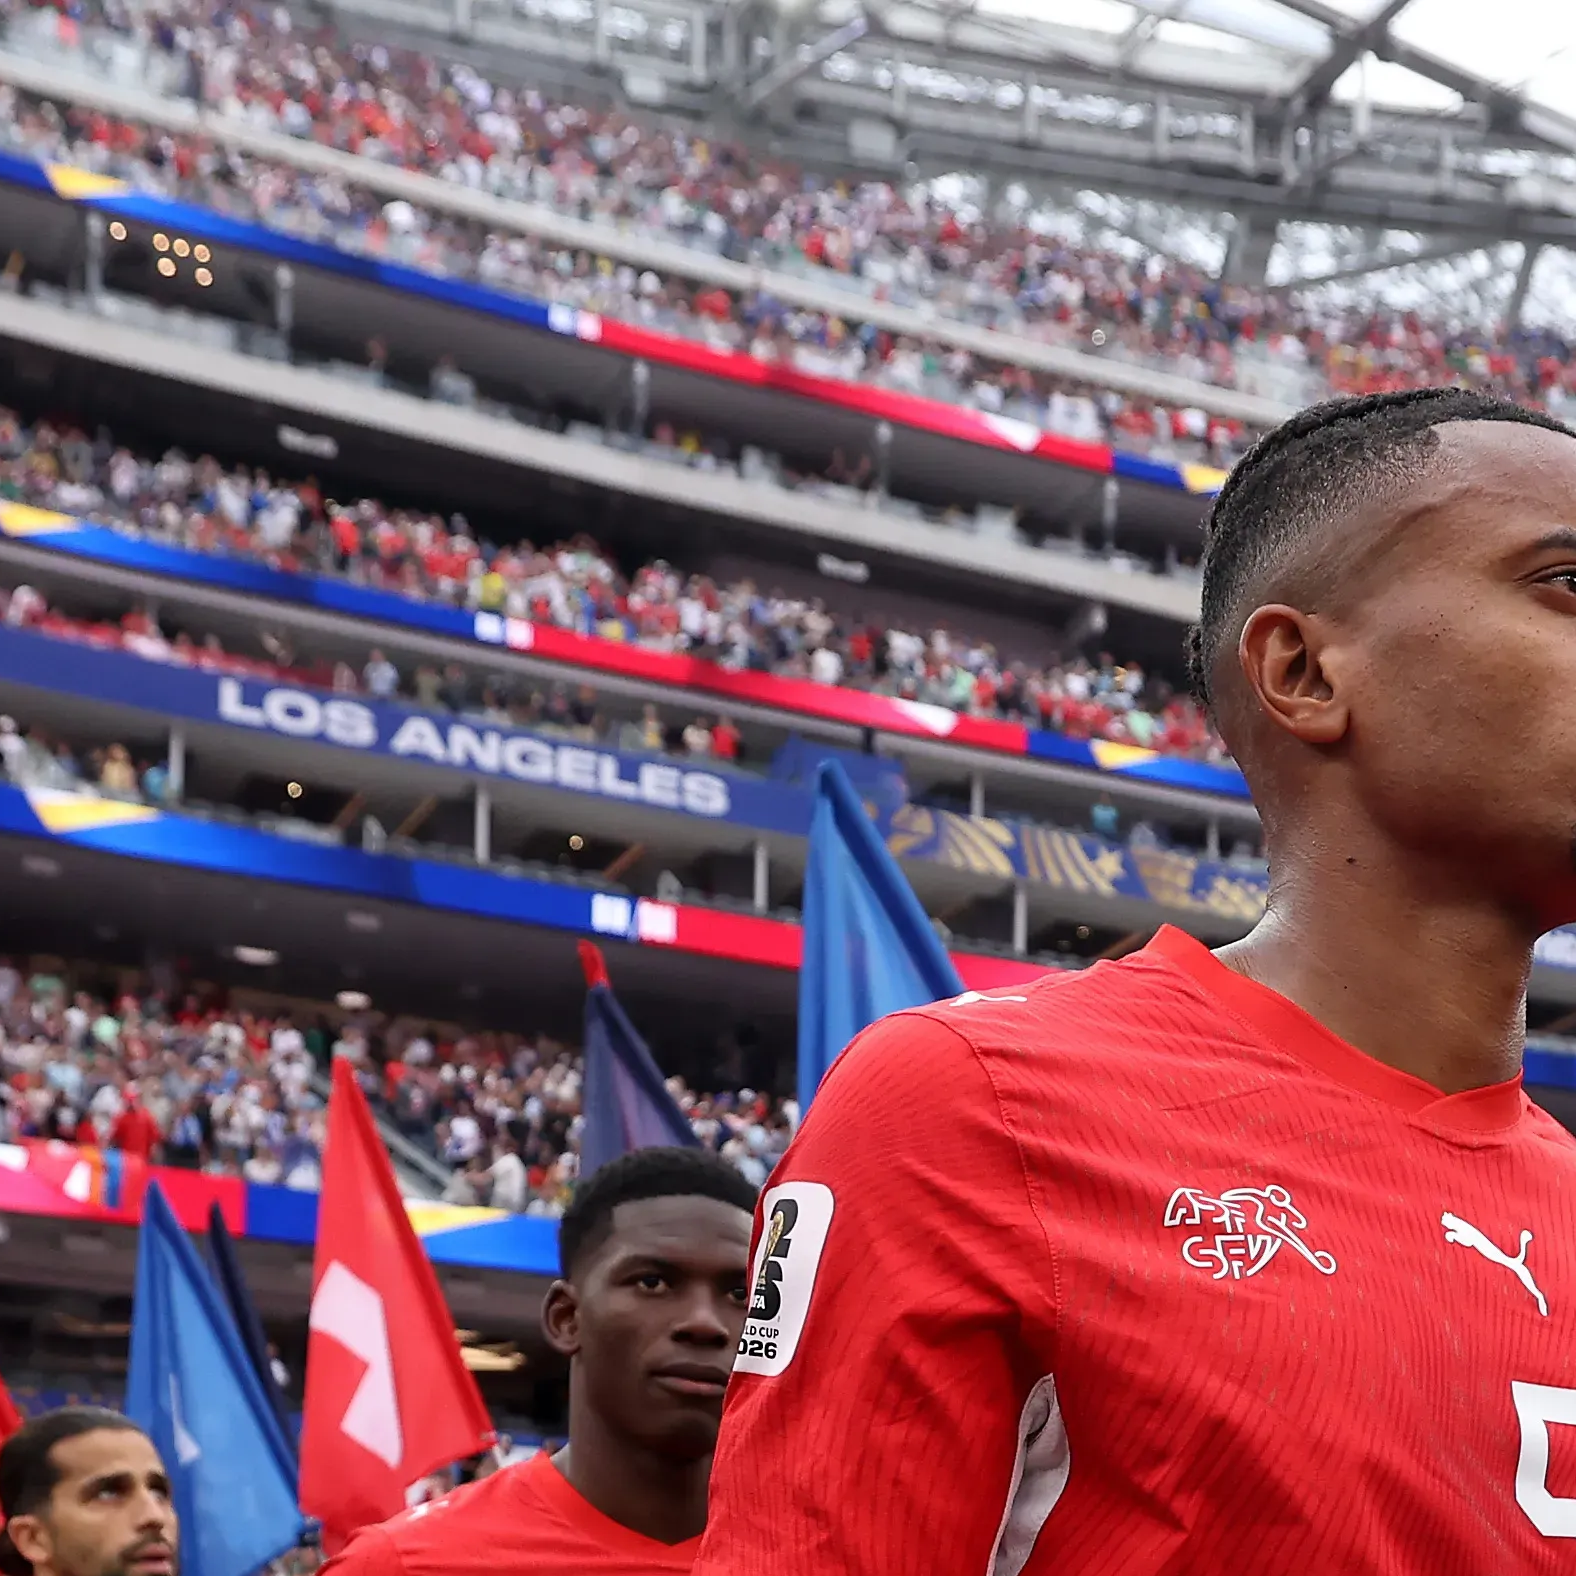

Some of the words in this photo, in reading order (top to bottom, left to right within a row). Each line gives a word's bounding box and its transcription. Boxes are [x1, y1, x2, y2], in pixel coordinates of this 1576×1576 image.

[218, 676, 378, 749] LOS
[390, 715, 730, 818] ANGELES
[738, 1338, 777, 1360] 026
